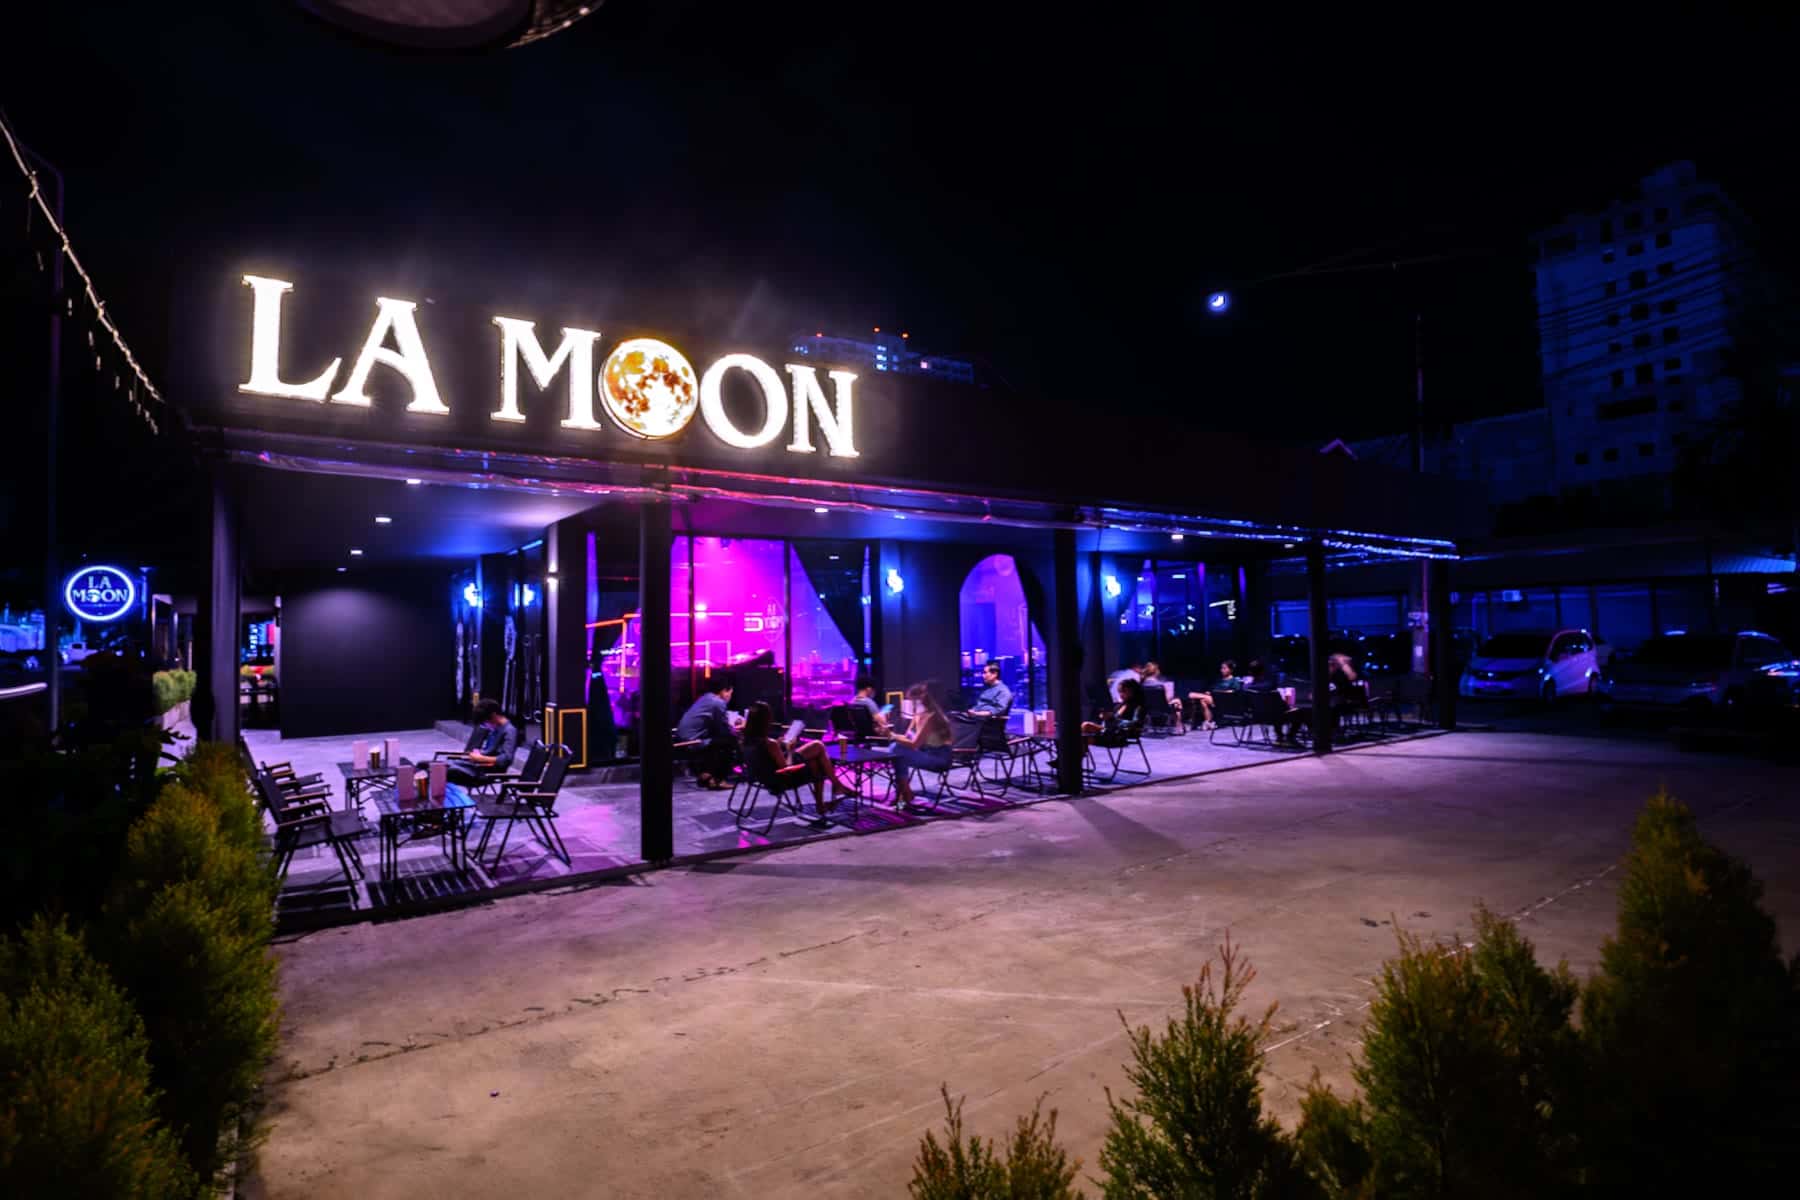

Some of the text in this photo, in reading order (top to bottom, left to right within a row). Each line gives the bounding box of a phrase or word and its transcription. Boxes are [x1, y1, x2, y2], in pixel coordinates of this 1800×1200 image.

[238, 274, 860, 458] LA MOON
[88, 576, 112, 589] LA
[72, 589, 128, 603] MOON
